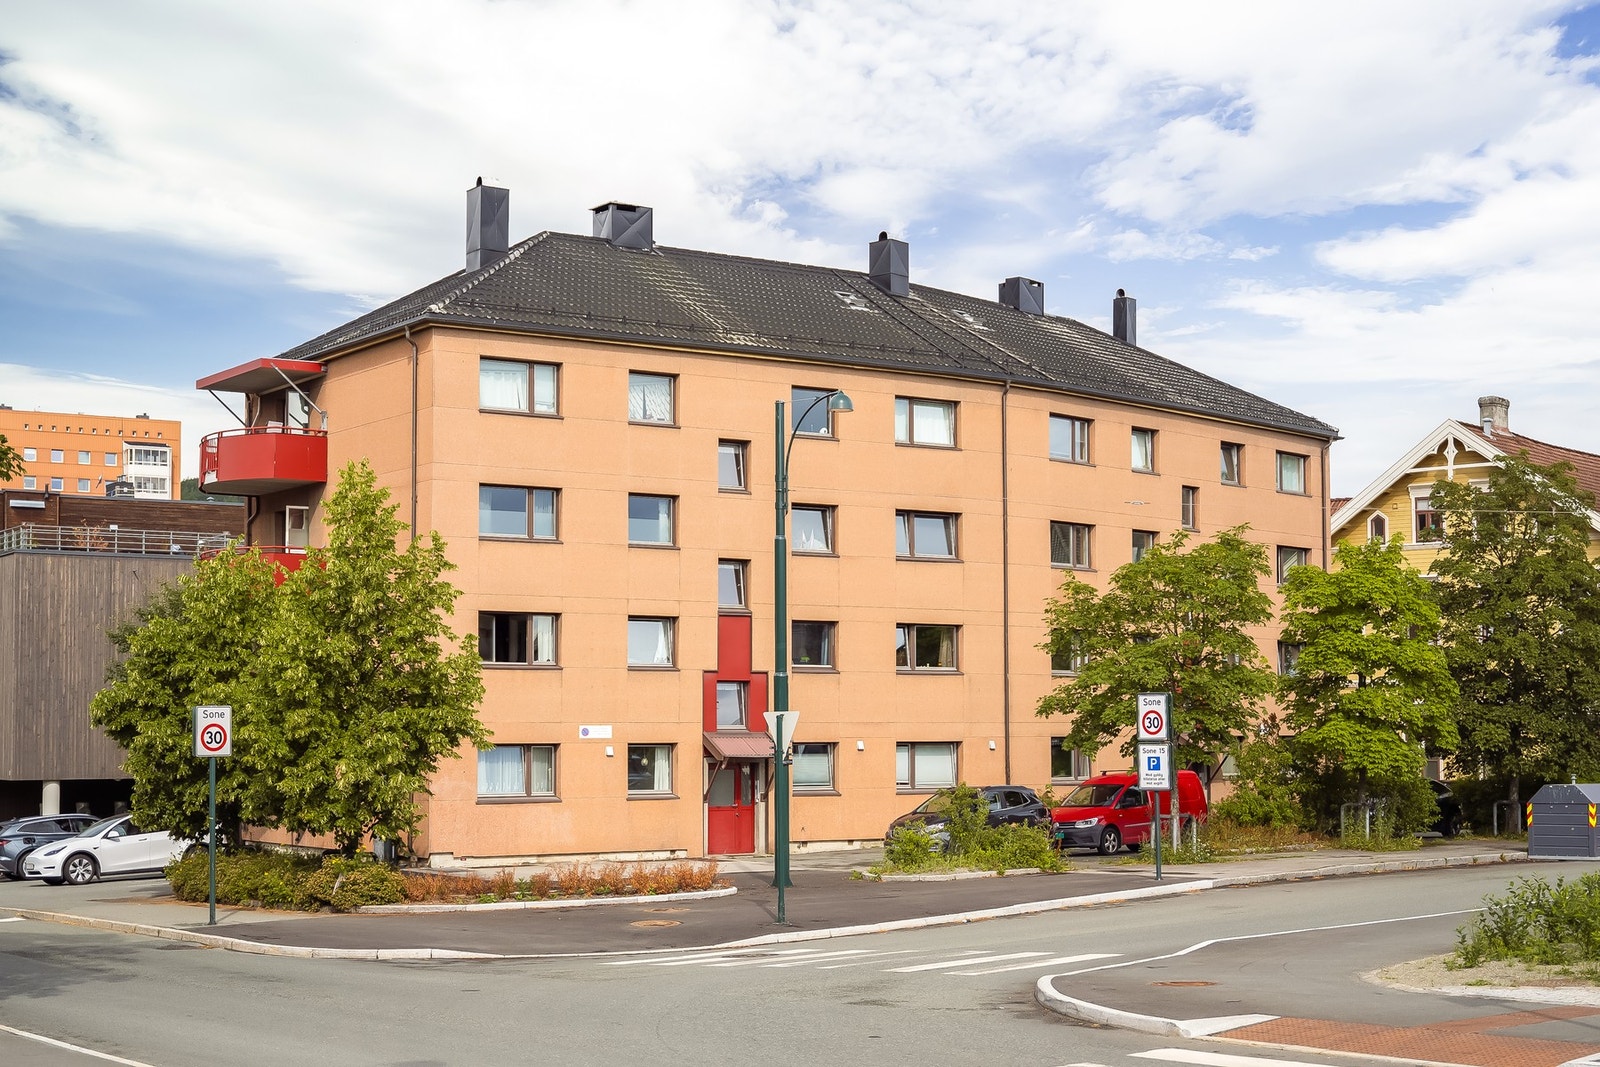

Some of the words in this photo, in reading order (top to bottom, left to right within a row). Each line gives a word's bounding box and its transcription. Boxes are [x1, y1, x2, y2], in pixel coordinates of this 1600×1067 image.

[1143, 698, 1161, 706] Sone
[202, 710, 225, 719] Sone
[1146, 716, 1160, 729] 30
[206, 730, 223, 745] 30
[1150, 757, 1158, 770] P
